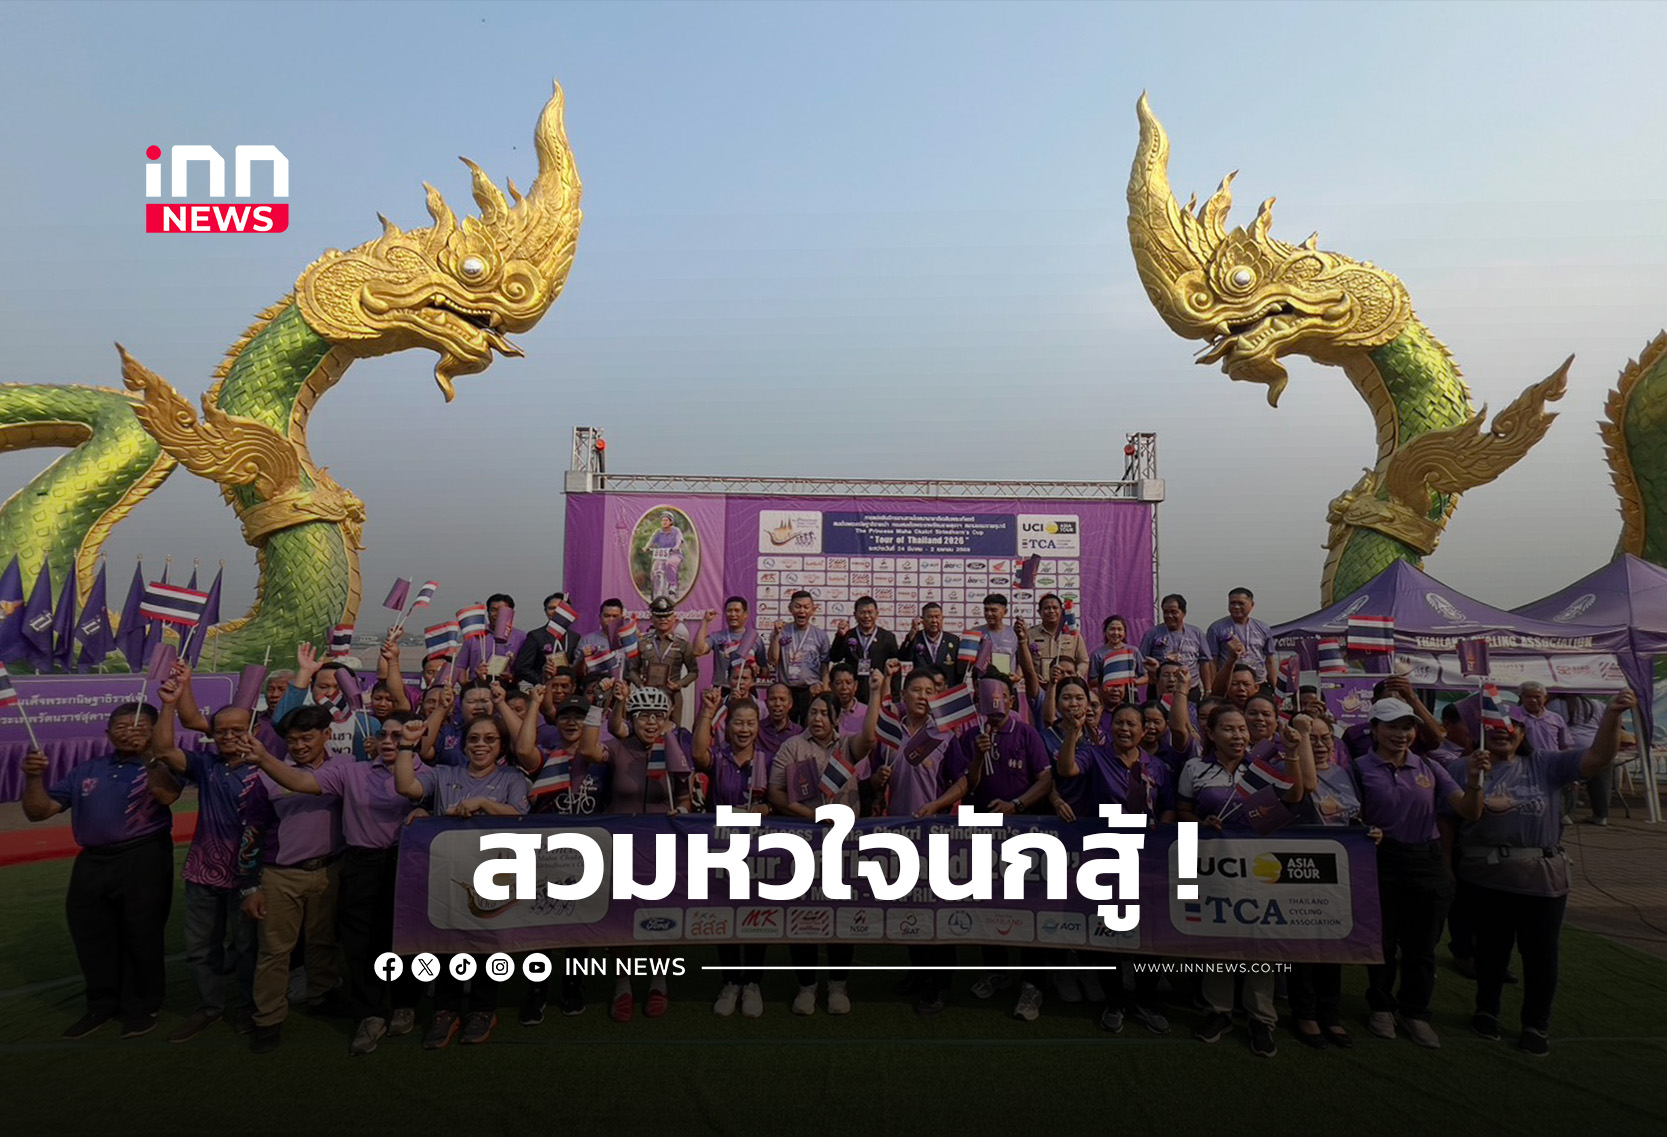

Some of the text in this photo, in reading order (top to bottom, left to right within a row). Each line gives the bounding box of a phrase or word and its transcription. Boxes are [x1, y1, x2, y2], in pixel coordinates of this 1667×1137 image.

[1022, 523, 1044, 532] UCI
[896, 535, 905, 544] of
[907, 535, 942, 545] Thailand
[1028, 539, 1056, 550] TCA
[1197, 857, 1247, 878] UCI
[1287, 857, 1316, 869] ASIA
[1287, 868, 1321, 880] TOUR
[1289, 898, 1329, 906] THAILAND
[1205, 895, 1288, 925] TCA
[1289, 907, 1322, 916] CYCLING
[742, 909, 778, 928] MK
[1290, 918, 1341, 926] ASSOCIATION
[1059, 922, 1081, 931] AOT
